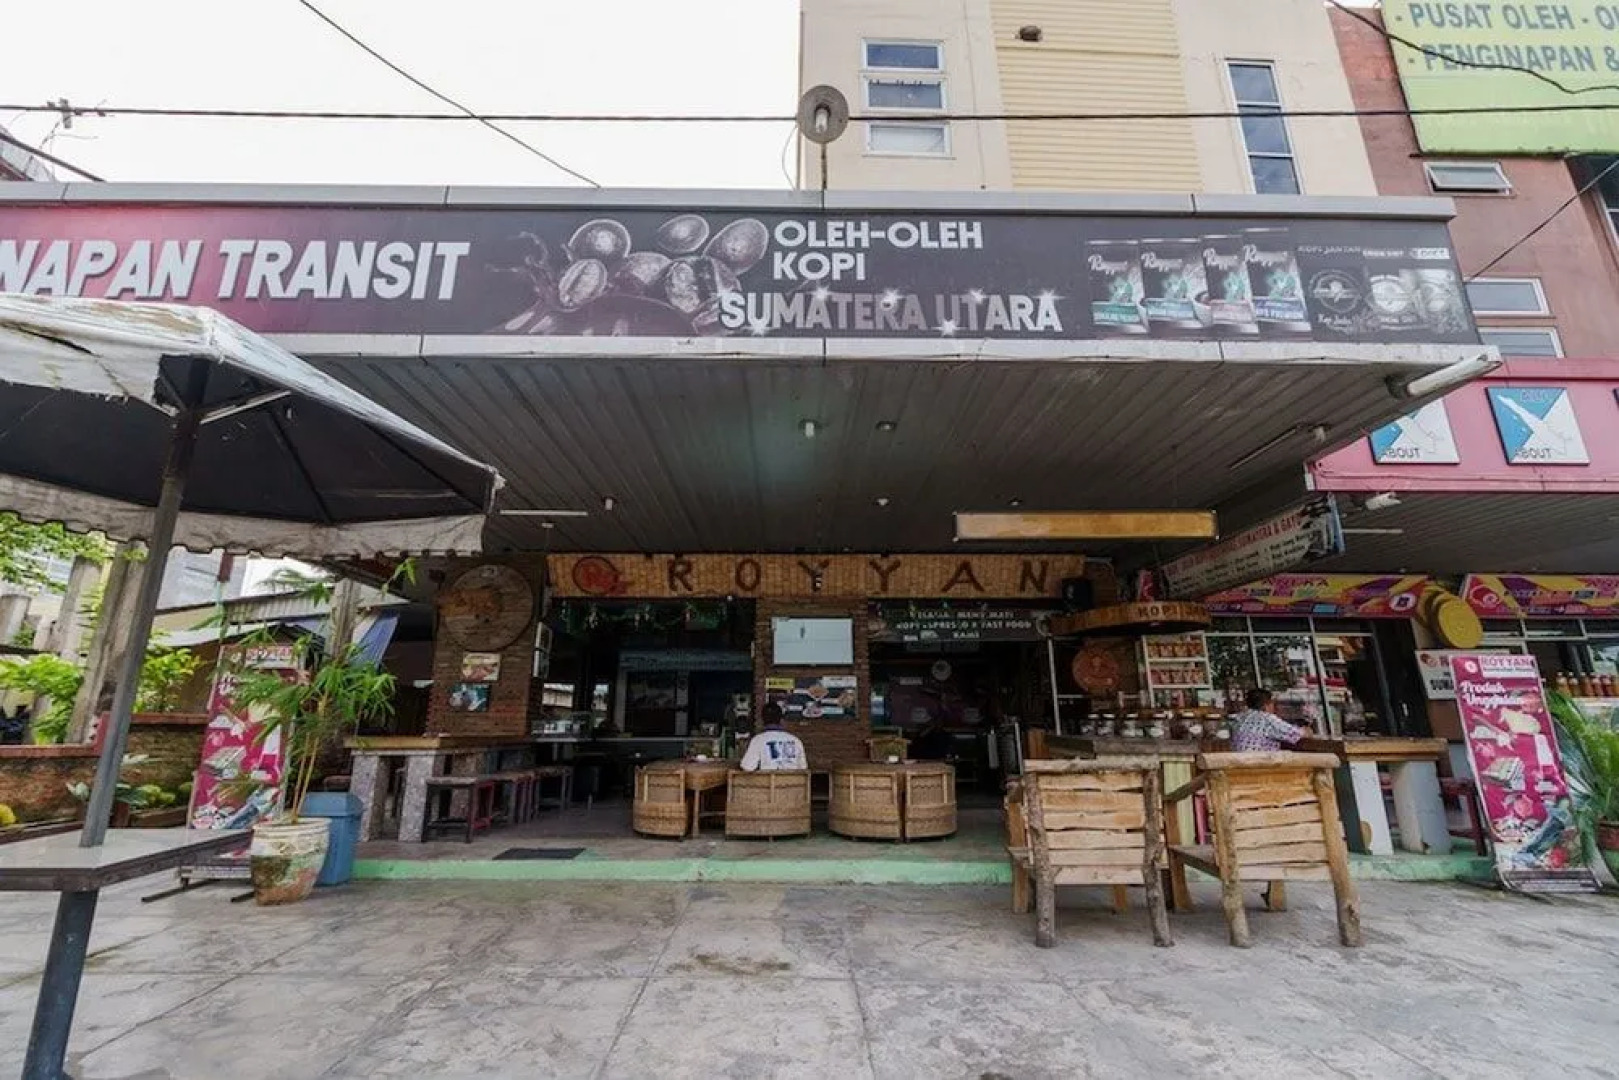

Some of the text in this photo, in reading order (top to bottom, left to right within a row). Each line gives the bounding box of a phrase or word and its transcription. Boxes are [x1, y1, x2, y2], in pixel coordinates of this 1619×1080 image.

[1409, 3, 1493, 28] PUSAT
[1502, 4, 1575, 30] OLEH
[1422, 43, 1597, 72] PENGINAPAN
[774, 219, 983, 249] OLEH-OLEH
[217, 240, 471, 300] TRANSIT
[773, 251, 867, 281] KOPI
[720, 291, 928, 332] SUMATERA
[935, 292, 1063, 333] UTARA
[1381, 447, 1421, 459] ABOUT
[1514, 448, 1552, 459] ABOUT
[667, 558, 1049, 593] ROYYAN
